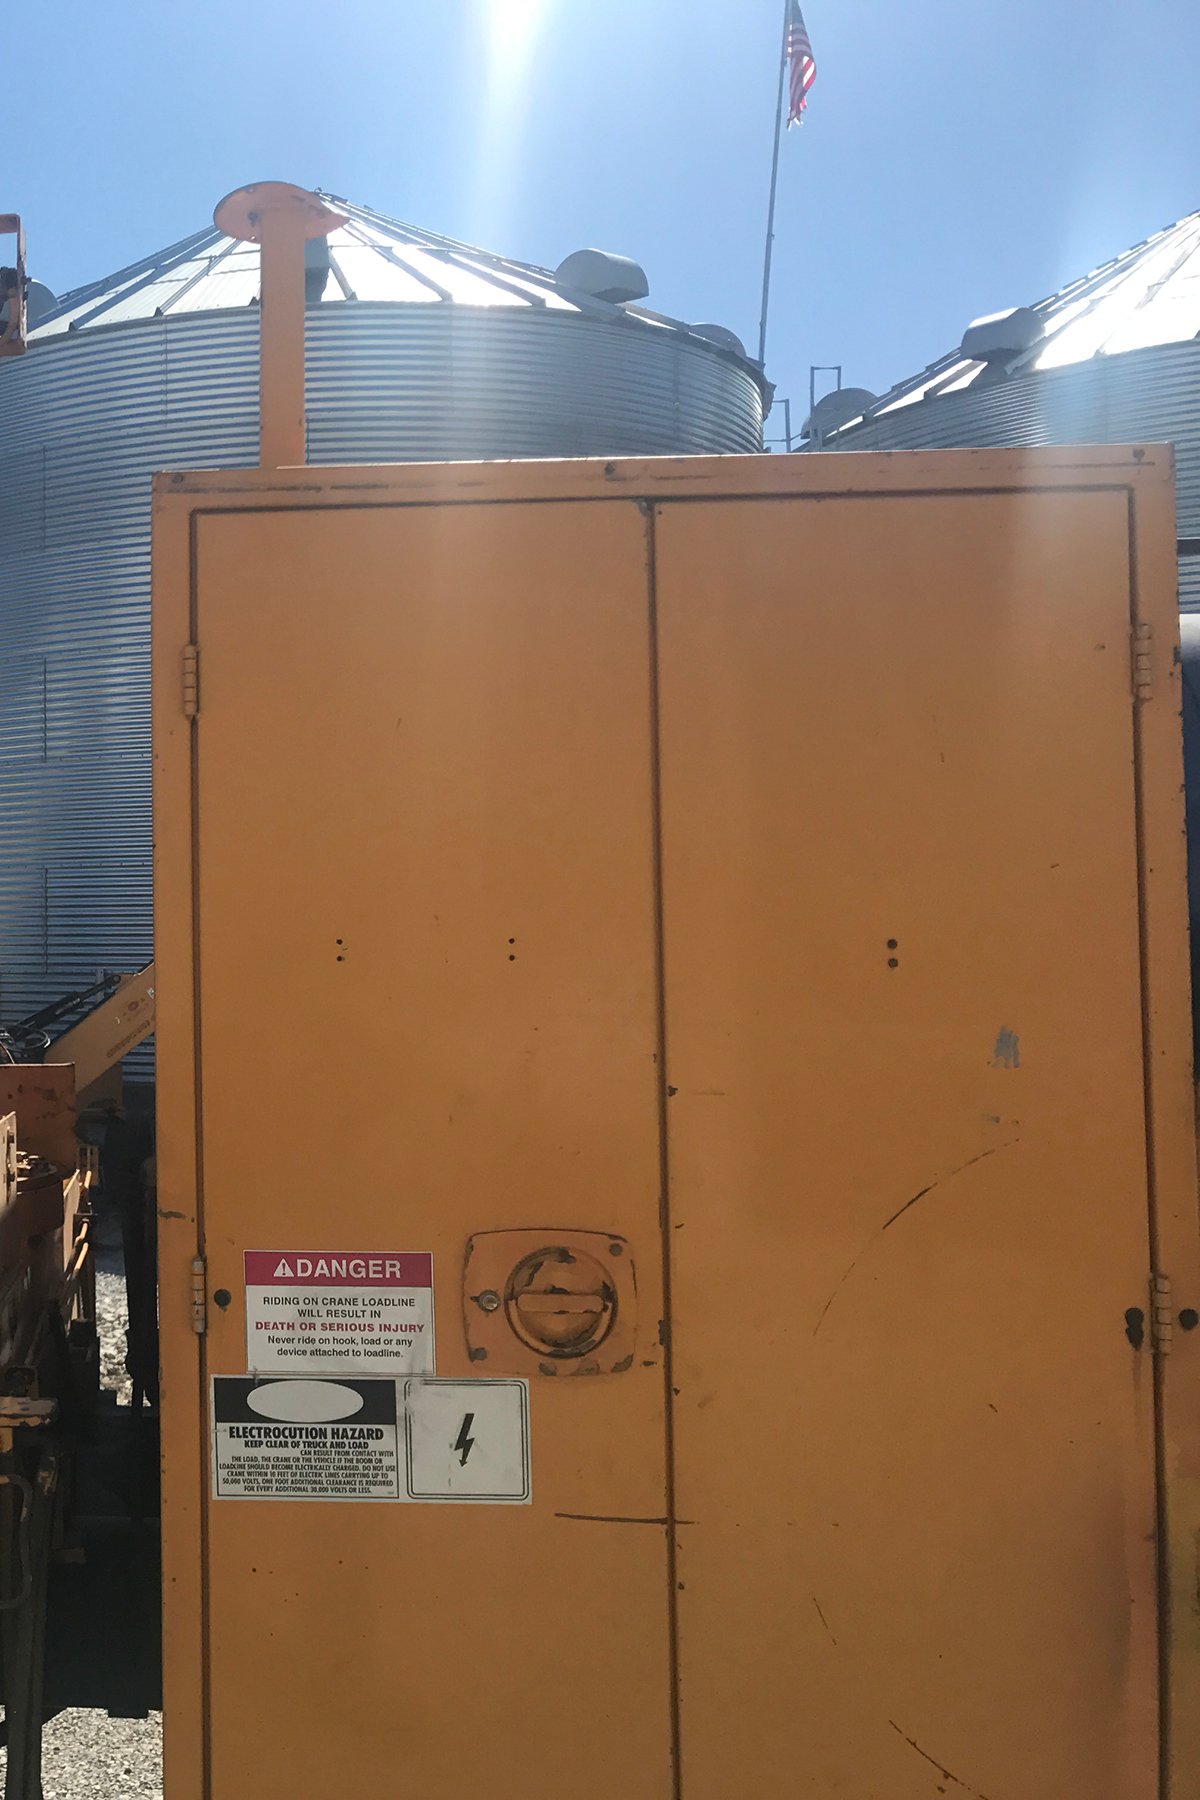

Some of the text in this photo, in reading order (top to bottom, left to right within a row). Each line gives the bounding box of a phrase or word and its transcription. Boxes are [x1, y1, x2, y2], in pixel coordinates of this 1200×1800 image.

[297, 1259, 401, 1278] DANGER
[263, 1297, 415, 1307] RIDING ON CRANE LOADLINE
[298, 1309, 381, 1318] WILL RESULT IN
[255, 1322, 424, 1332] DEATH OR SERIOUS INJURY
[268, 1336, 295, 1344] Never
[298, 1337, 316, 1345] ride
[333, 1337, 359, 1346] hook,
[361, 1337, 381, 1345] load
[396, 1339, 412, 1348] any
[310, 1349, 349, 1357] attached
[229, 1427, 383, 1440] ELECTROCUTION HAZARD
[244, 1440, 263, 1448] KEEP
